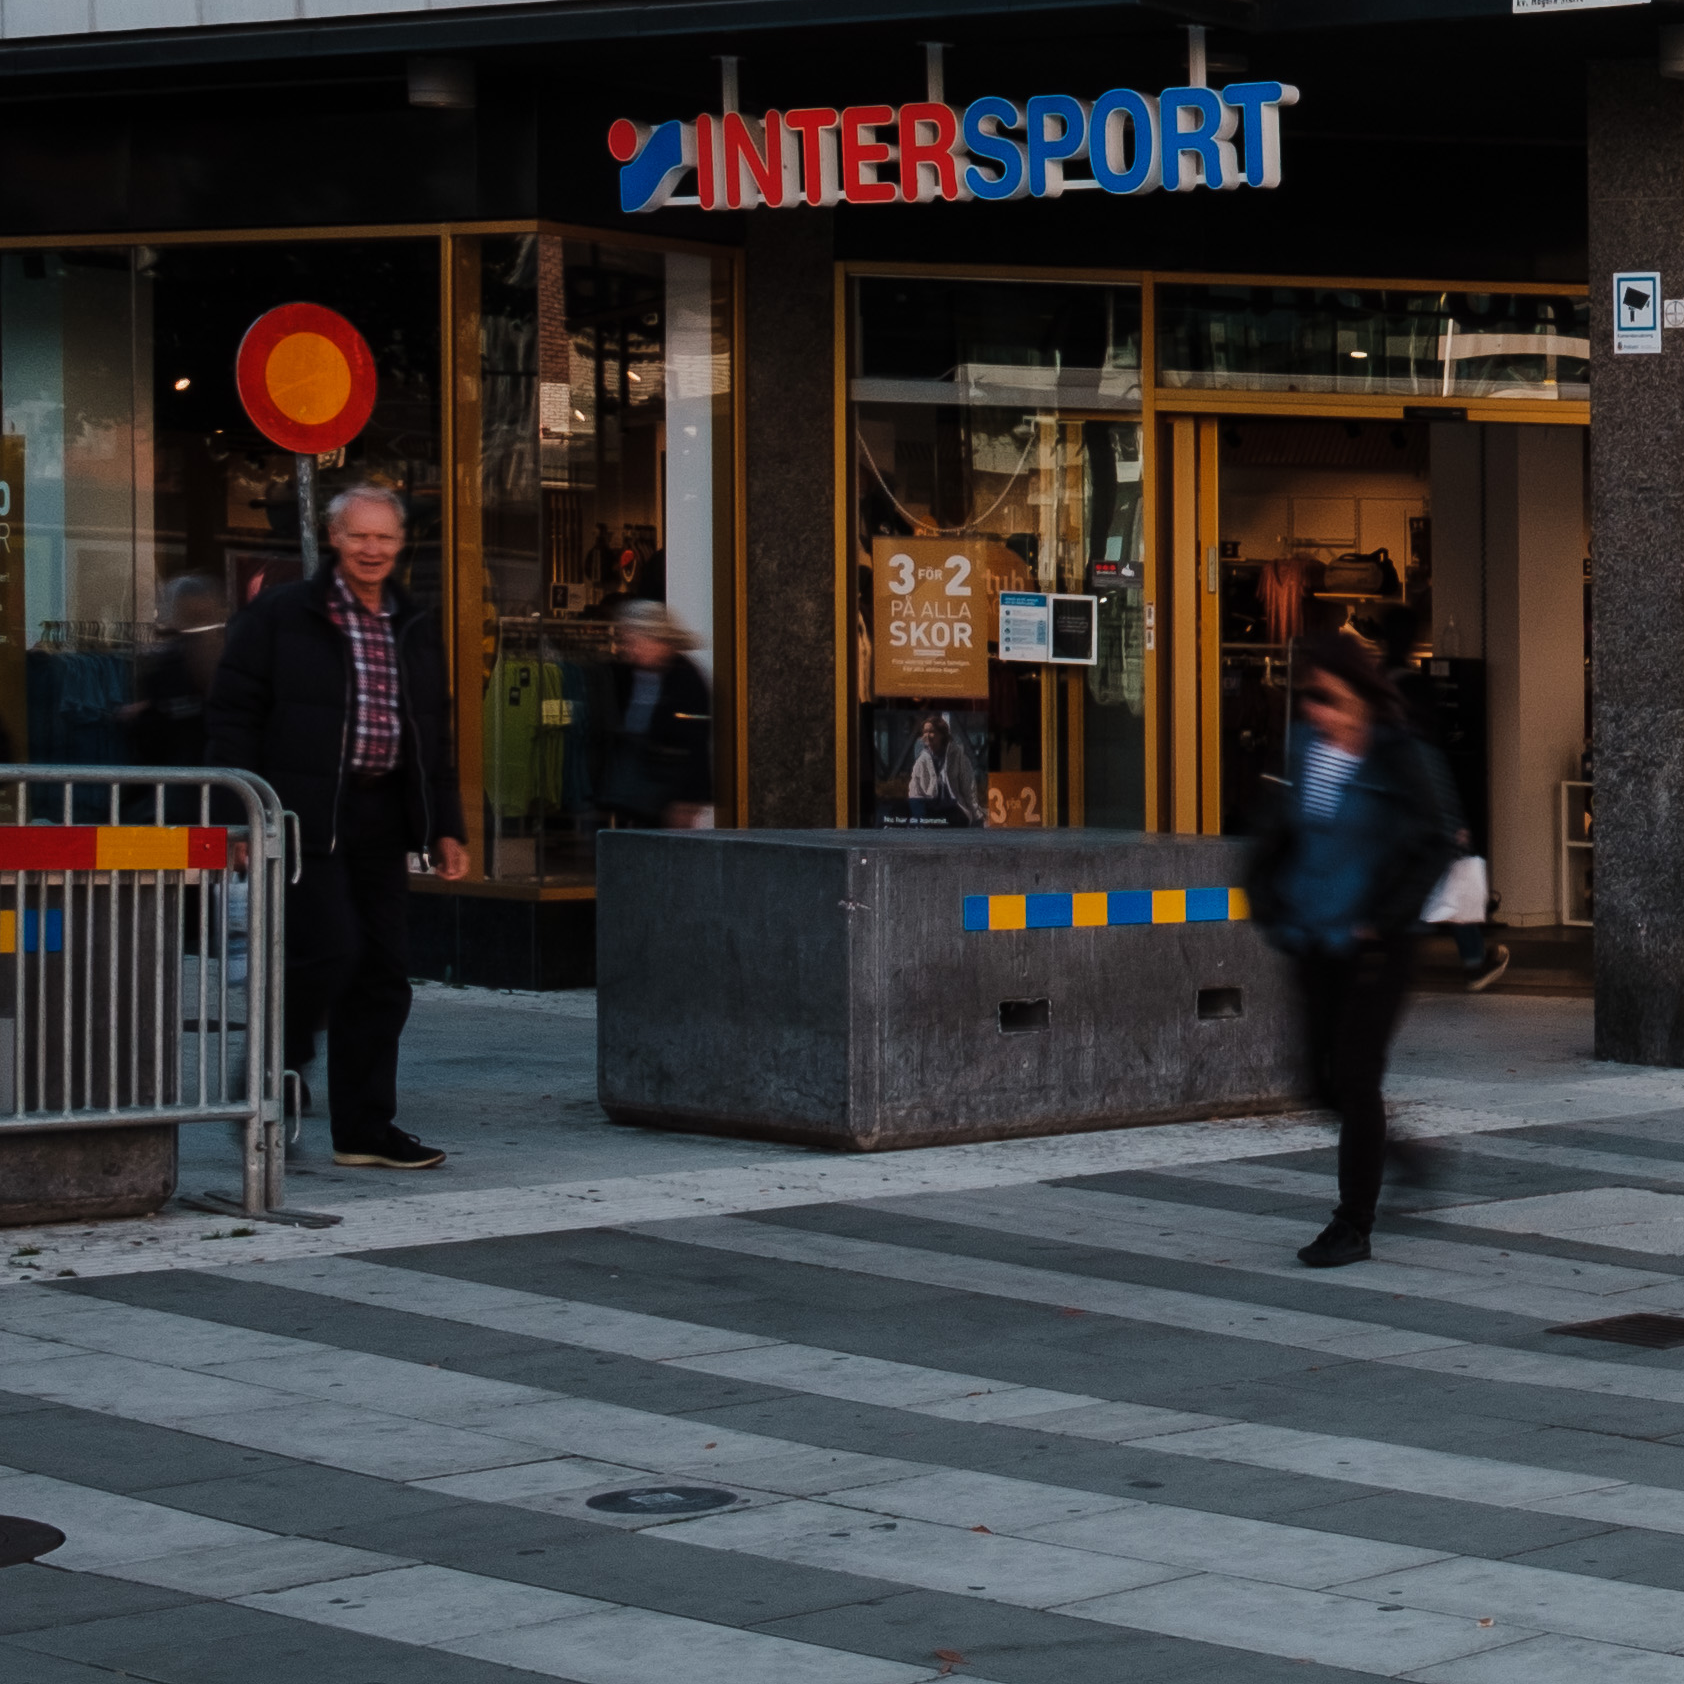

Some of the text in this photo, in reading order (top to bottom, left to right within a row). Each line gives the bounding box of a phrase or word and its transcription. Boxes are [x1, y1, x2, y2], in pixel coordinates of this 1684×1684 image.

[698, 81, 1294, 210] INTERSPORT
[888, 553, 972, 597] 3 FÖR 2
[890, 594, 916, 618] PÅ
[920, 599, 972, 619] ALLA
[889, 621, 973, 649] SKOR
[988, 787, 1005, 824] 3
[1021, 786, 1041, 822] 2
